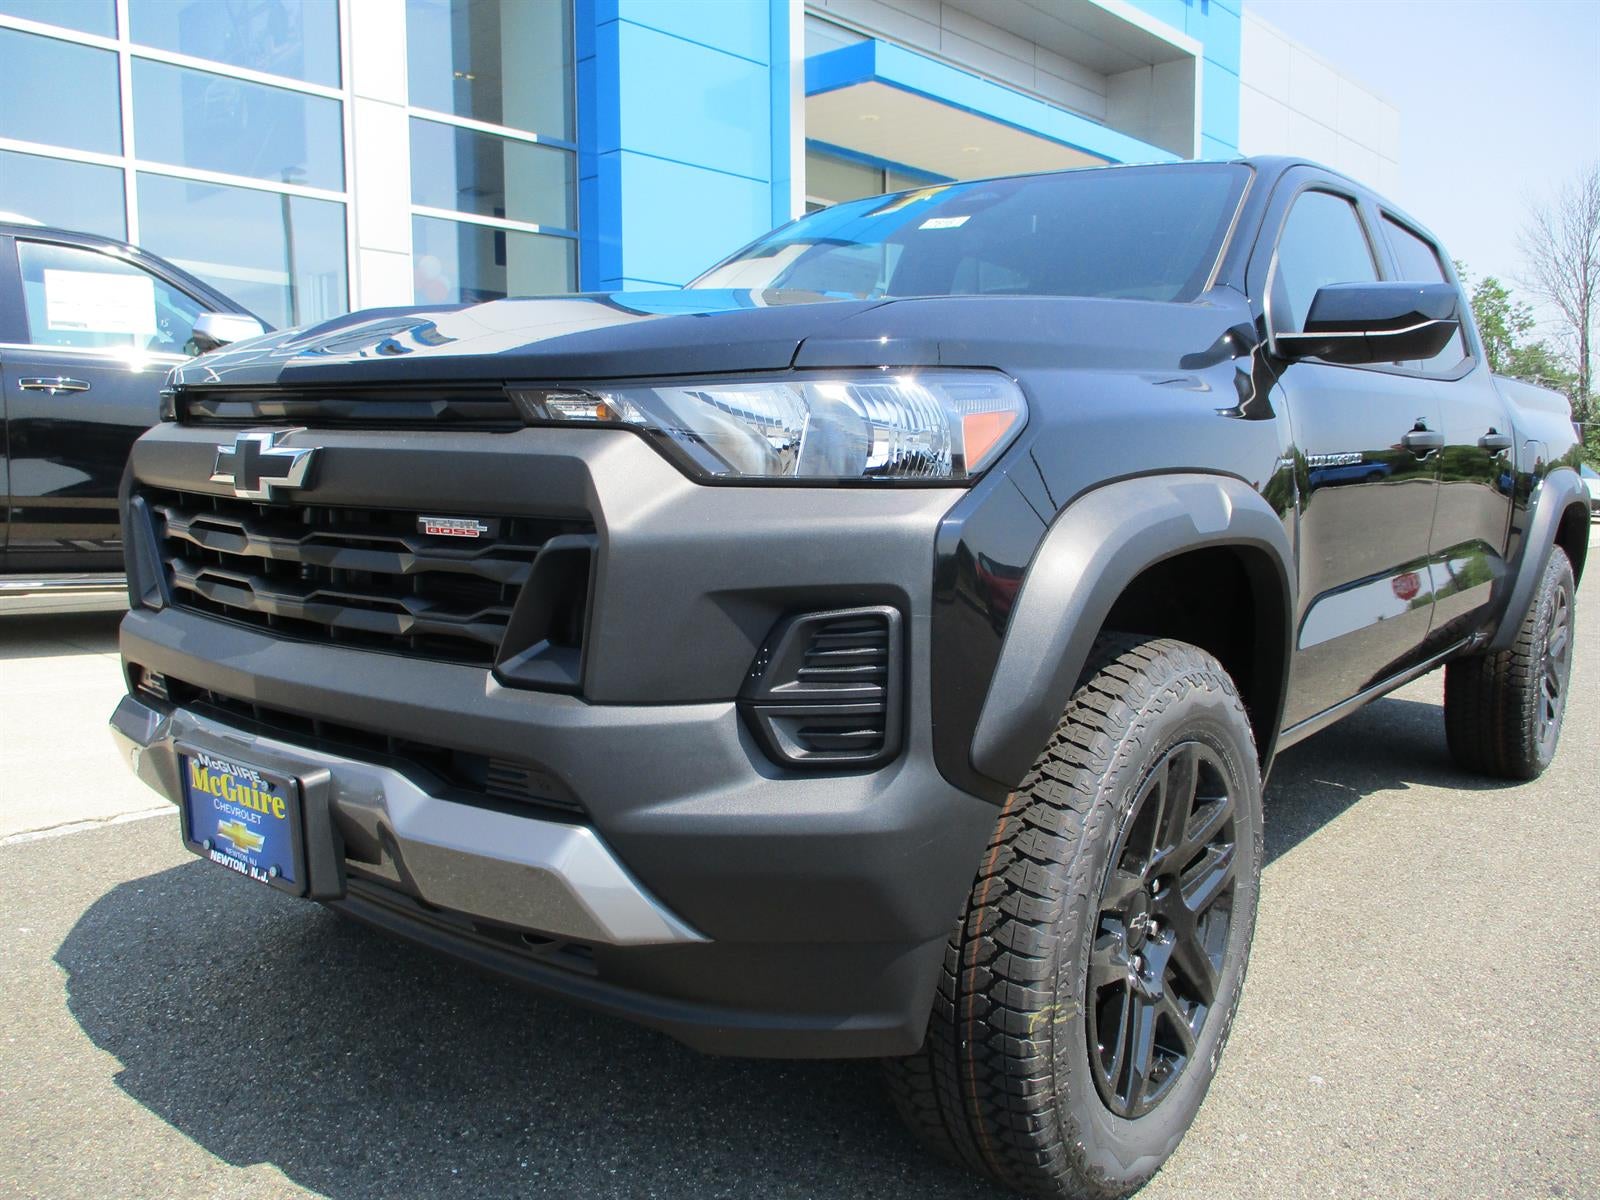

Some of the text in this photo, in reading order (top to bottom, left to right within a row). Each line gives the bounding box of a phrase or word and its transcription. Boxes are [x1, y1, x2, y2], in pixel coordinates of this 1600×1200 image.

[427, 526, 479, 537] BOSS
[199, 753, 263, 783] McGUIRE
[192, 763, 286, 819] McGuire
[213, 799, 262, 824] CHEVROLET
[210, 850, 269, 883] NEWTON, N.J.
